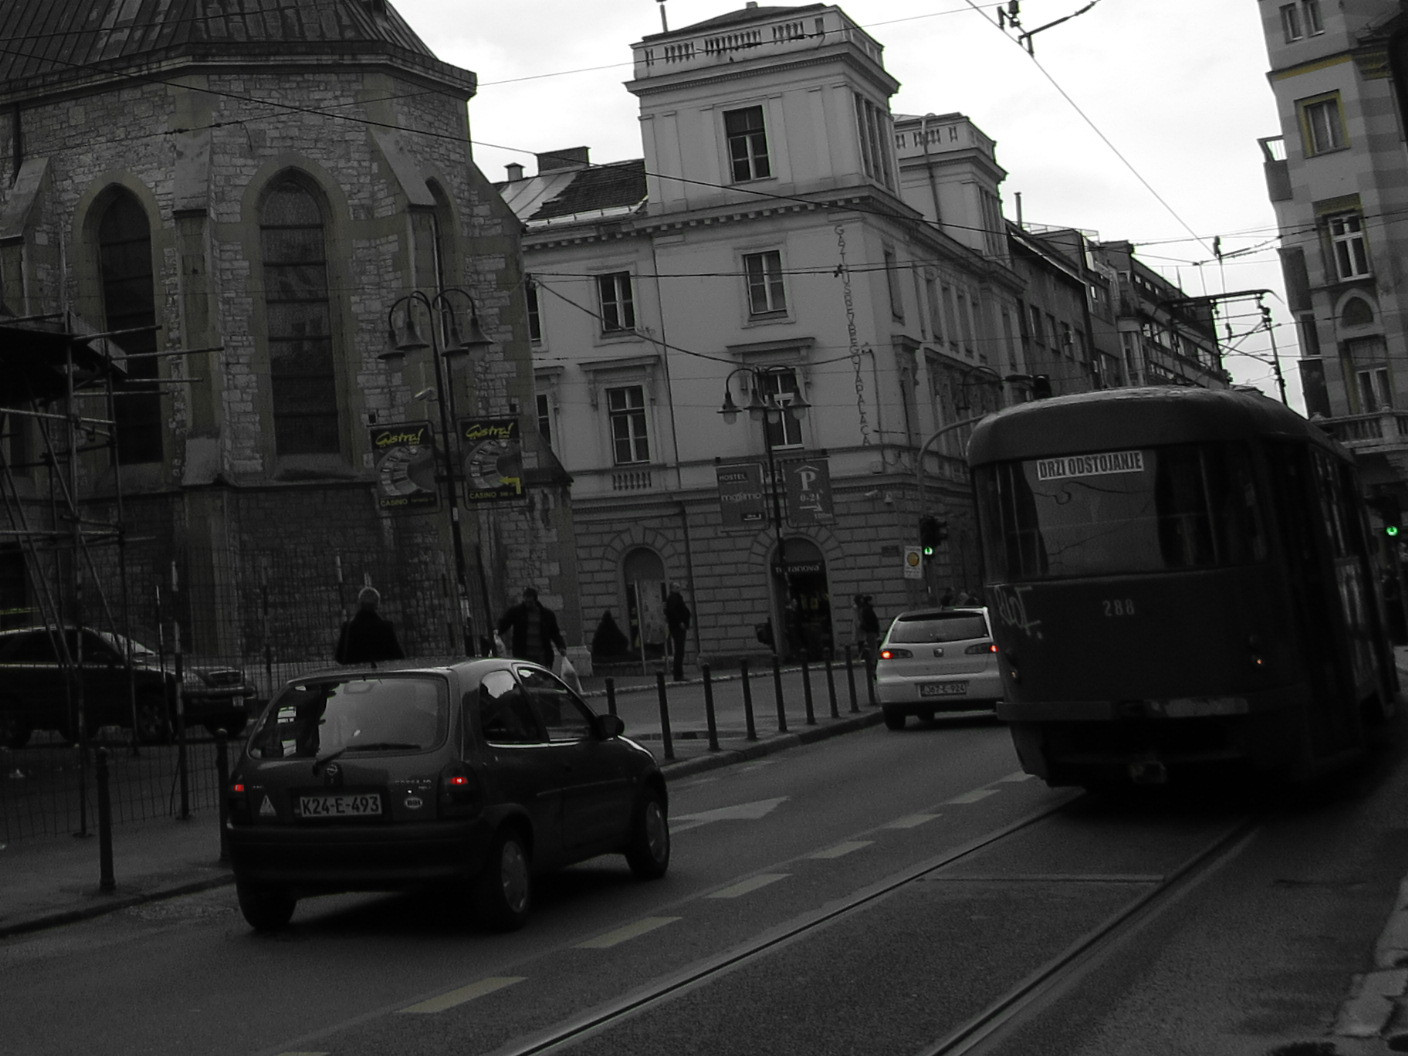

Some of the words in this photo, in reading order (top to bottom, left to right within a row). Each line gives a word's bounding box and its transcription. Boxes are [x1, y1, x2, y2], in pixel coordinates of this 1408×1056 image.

[1068, 452, 1142, 475] ODSTOJANJE
[719, 473, 746, 481] HOSTEL
[800, 471, 816, 491] P
[469, 491, 497, 500] CASINO
[1102, 598, 1135, 617] 288
[302, 796, 379, 815] K24-E-493
